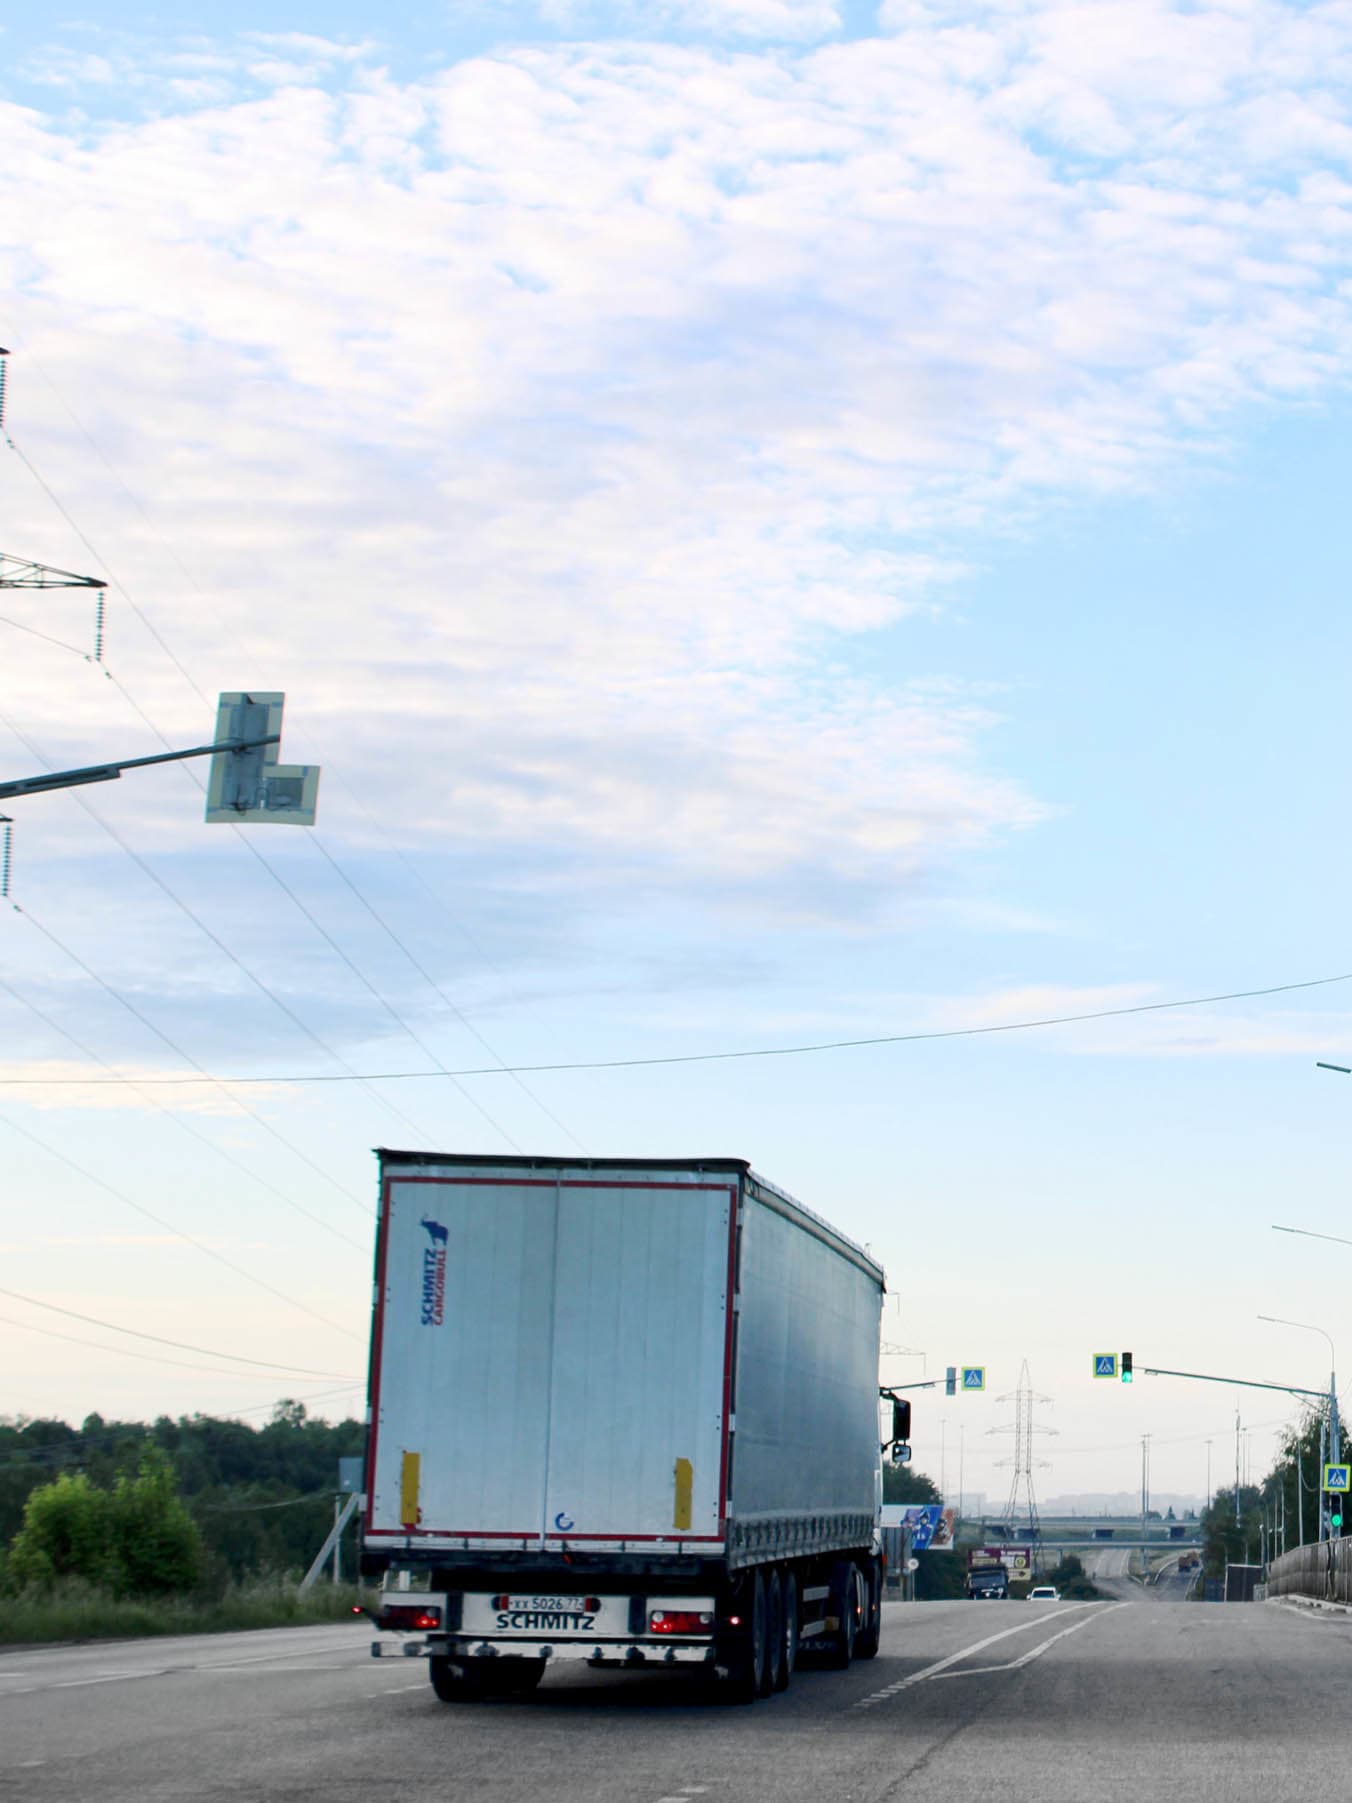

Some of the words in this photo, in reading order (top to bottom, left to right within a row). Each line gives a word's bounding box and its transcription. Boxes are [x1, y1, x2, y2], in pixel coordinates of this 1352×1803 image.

[422, 1248, 435, 1325] SCHMITZ
[532, 1598, 563, 1610] 5026
[496, 1614, 595, 1630] SCHMITZ
